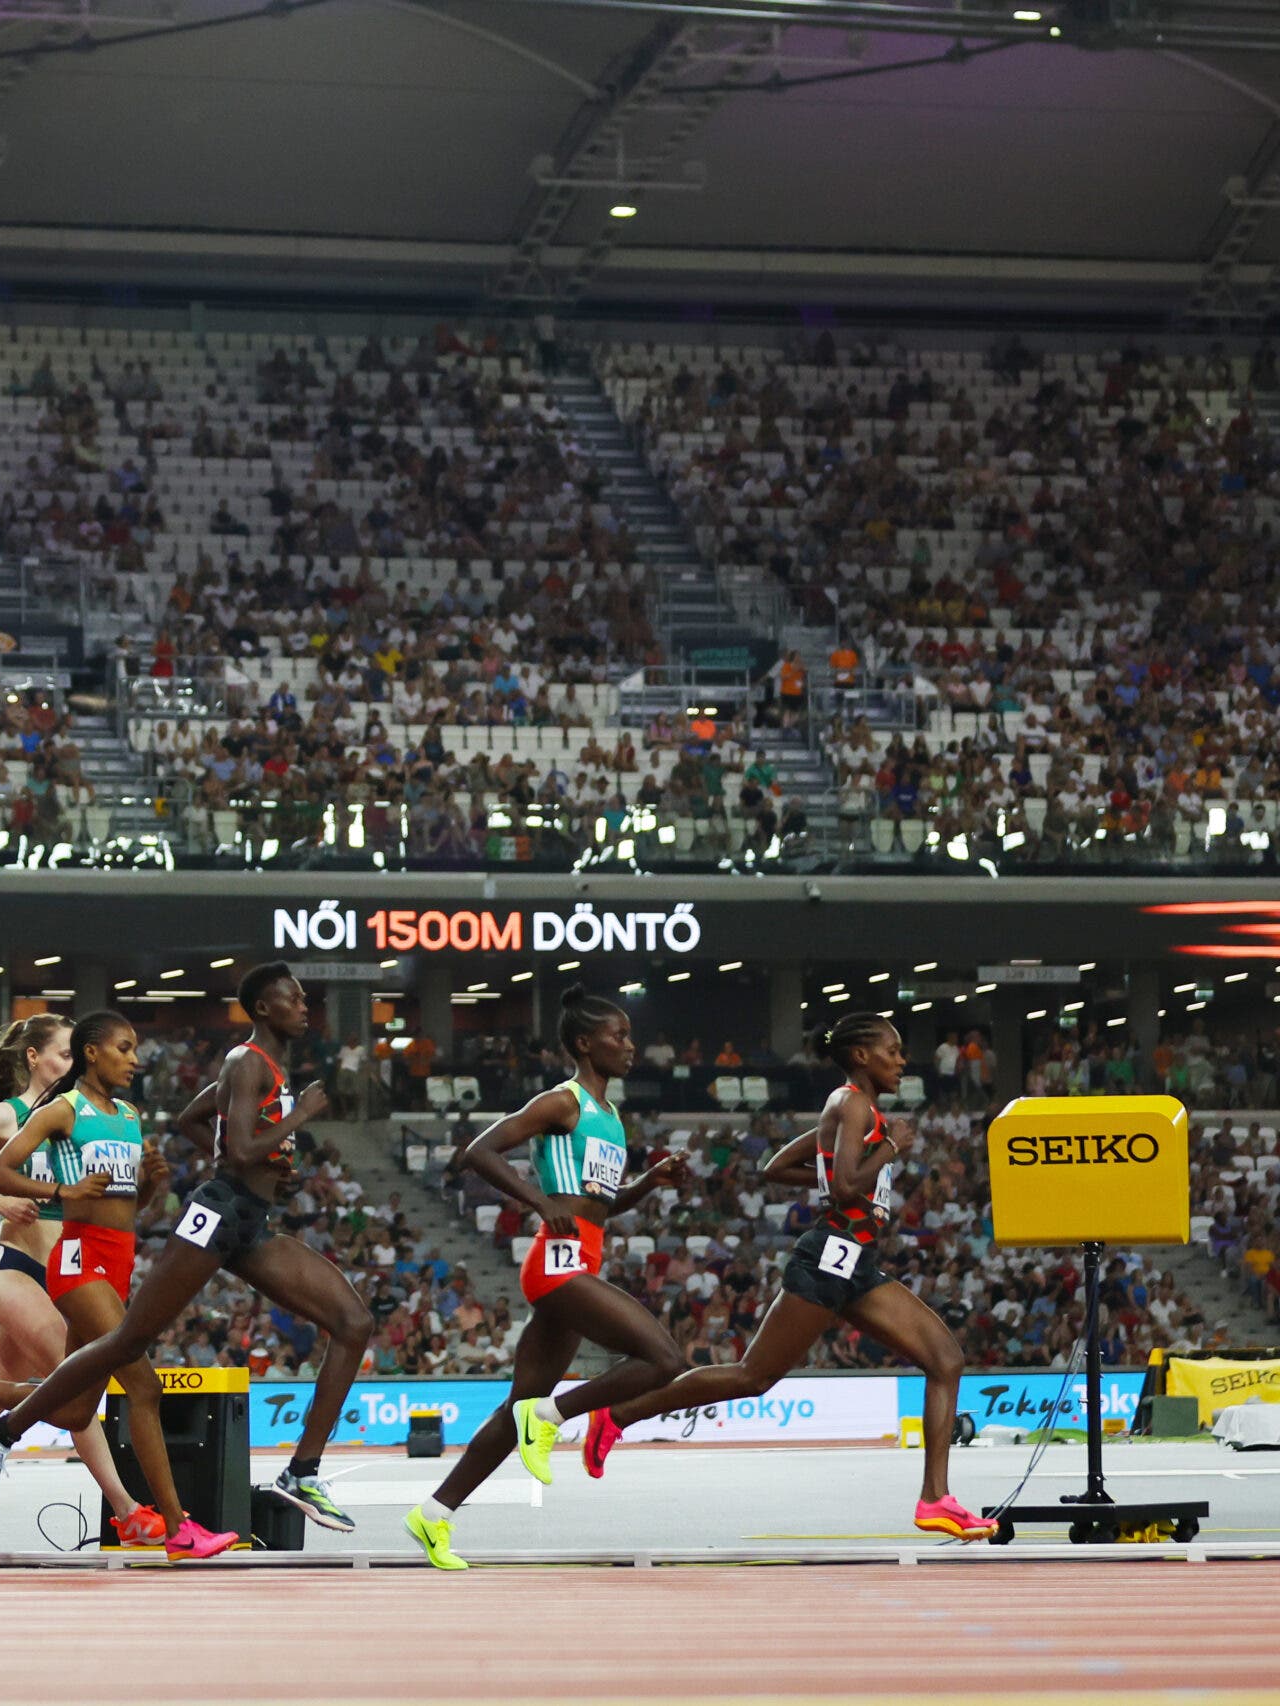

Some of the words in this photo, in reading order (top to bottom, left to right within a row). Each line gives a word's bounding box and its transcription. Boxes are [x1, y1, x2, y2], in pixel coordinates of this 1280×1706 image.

[273, 900, 357, 950] NŐI
[367, 911, 522, 951] 1500M
[533, 901, 701, 952] DÖNTŐ
[94, 1143, 131, 1159] NTN
[599, 1143, 624, 1167] NTN
[1007, 1133, 1159, 1166] SEIKO
[189, 1212, 208, 1235] 9
[70, 1246, 81, 1269] 4
[551, 1244, 574, 1268] 12
[832, 1245, 850, 1271] 2
[160, 1372, 203, 1389] IKO
[979, 1384, 1073, 1429] Tokyo
